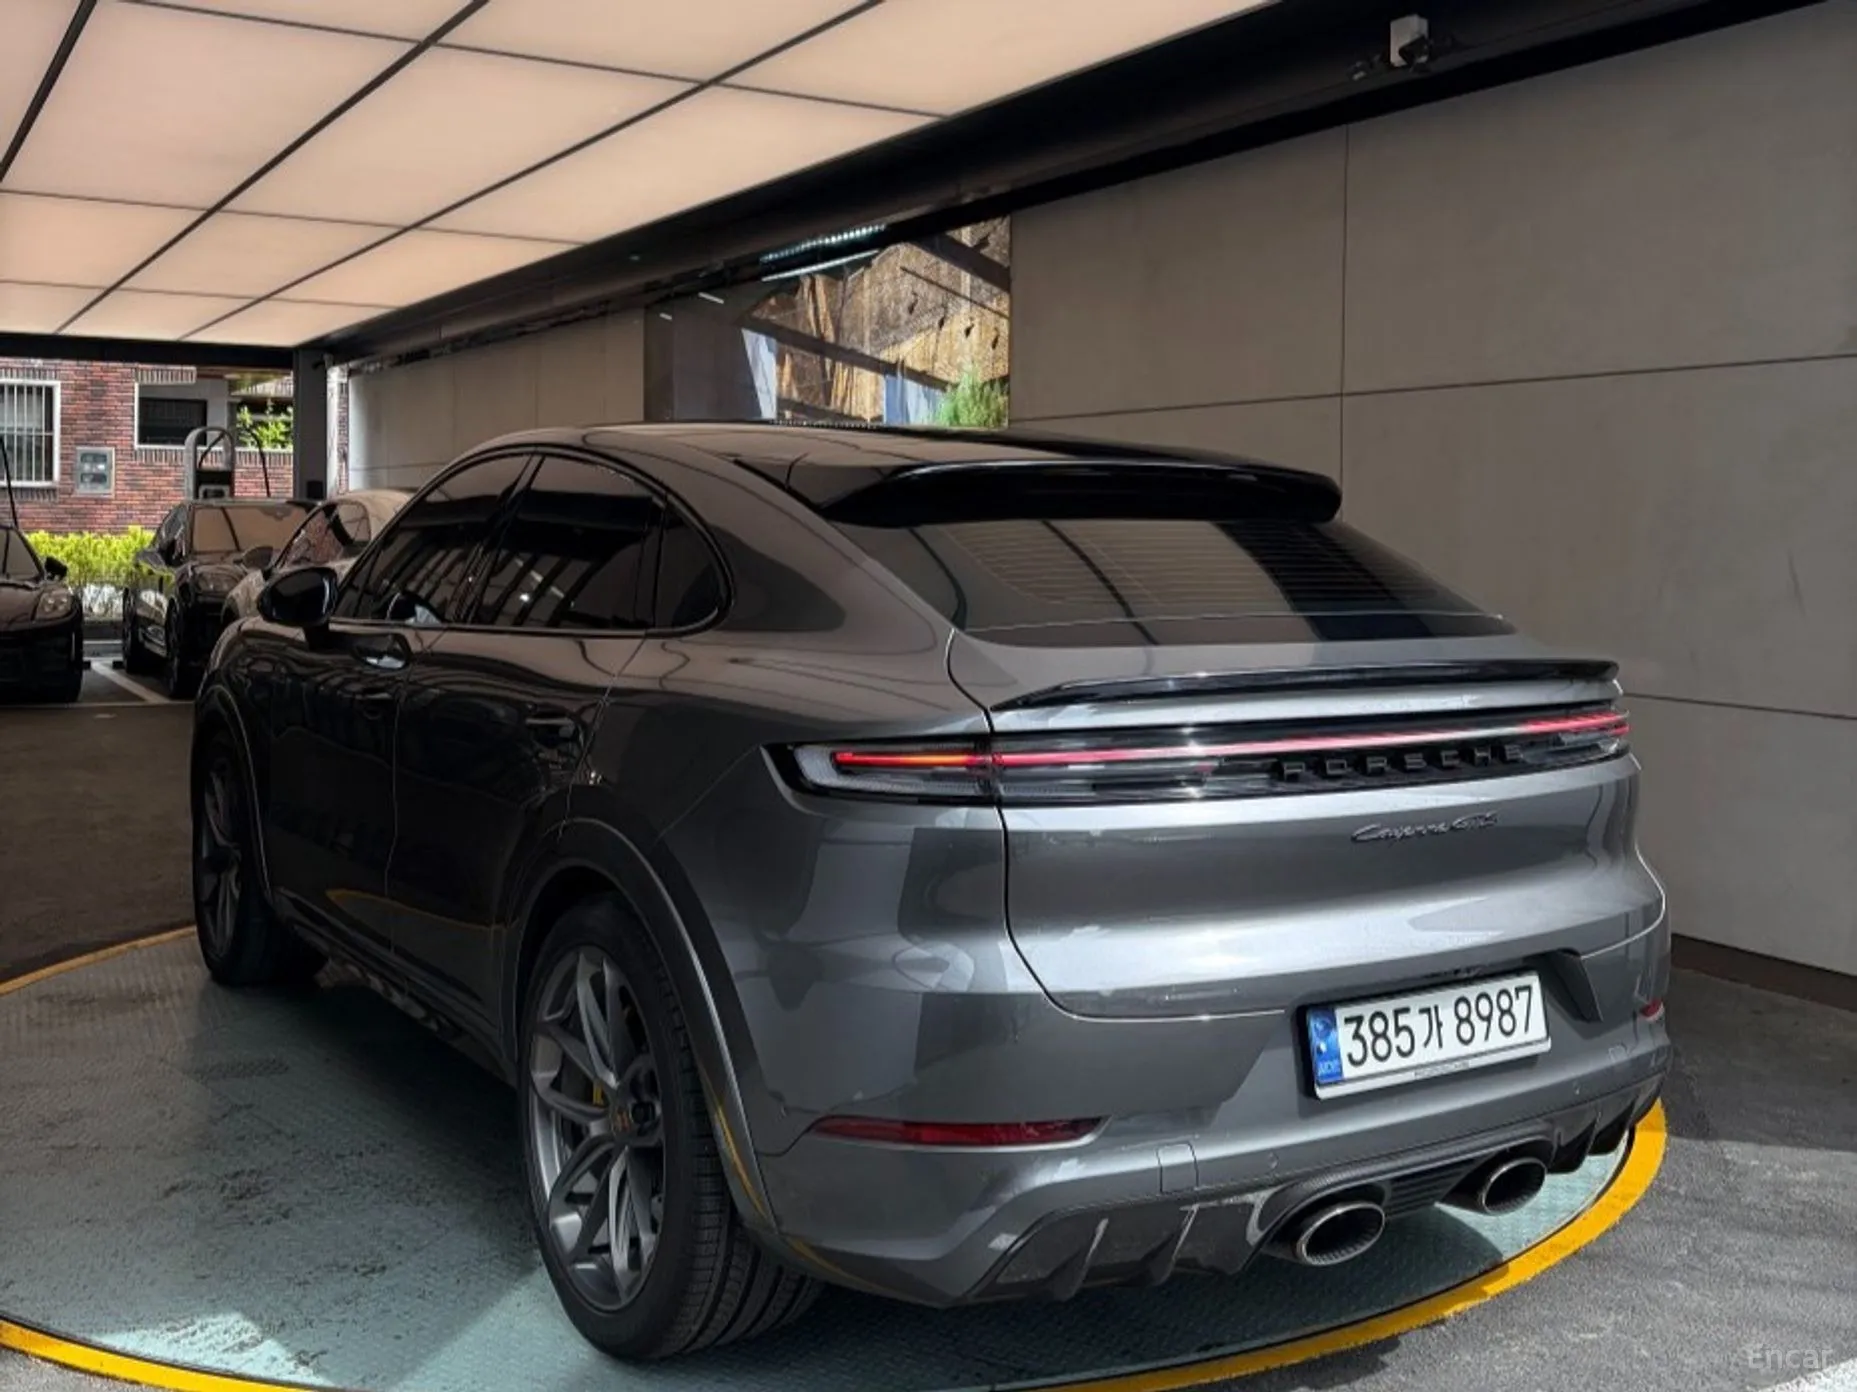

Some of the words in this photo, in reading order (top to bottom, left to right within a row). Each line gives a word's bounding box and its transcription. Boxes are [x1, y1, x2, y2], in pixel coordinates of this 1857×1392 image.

[1283, 744, 1524, 779] PORSCHE
[1344, 1004, 1444, 1067] 385가
[1454, 985, 1534, 1046] 8987
